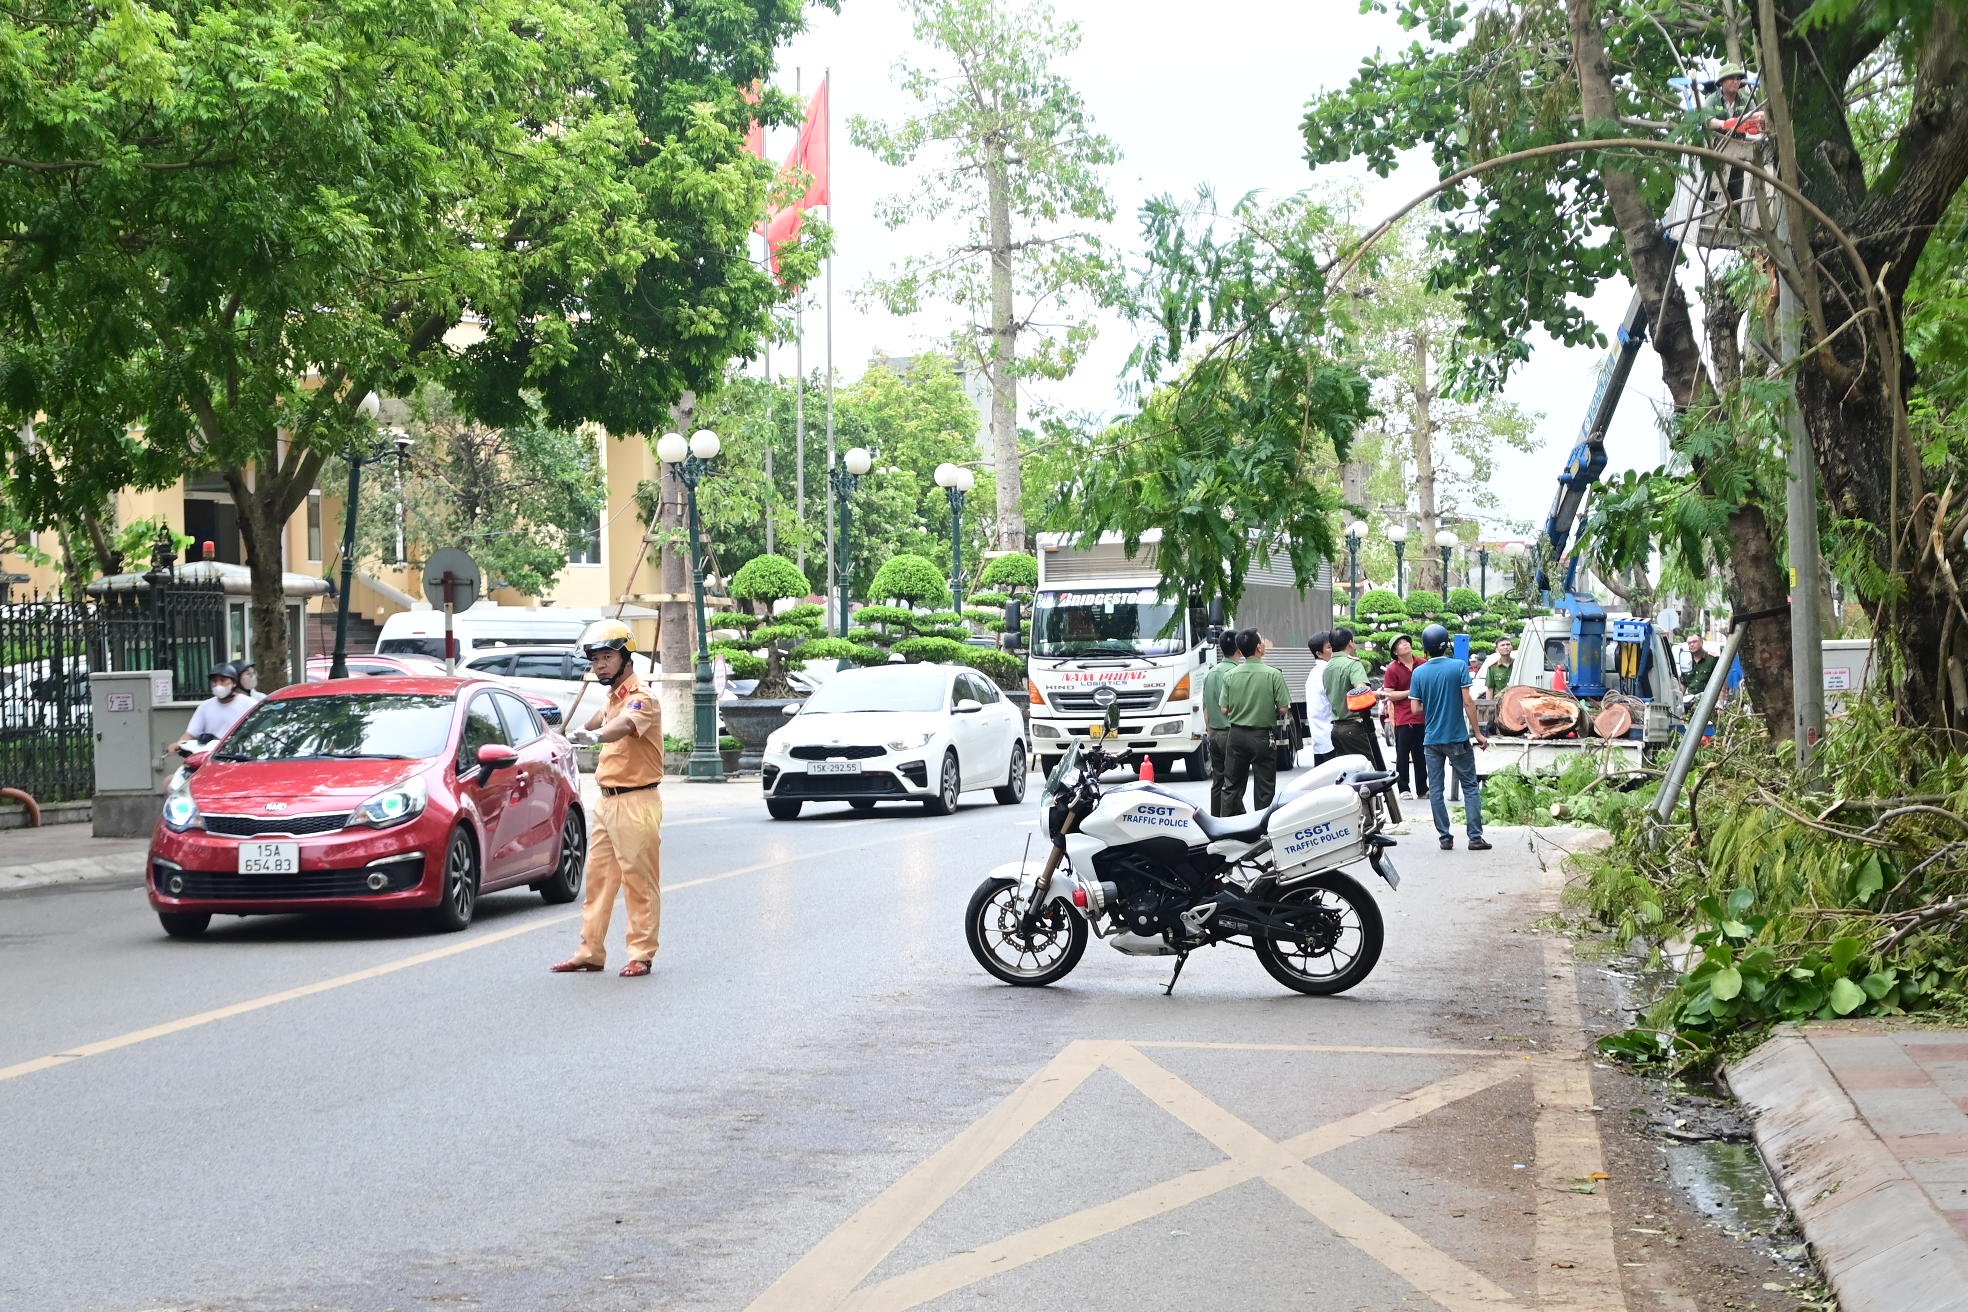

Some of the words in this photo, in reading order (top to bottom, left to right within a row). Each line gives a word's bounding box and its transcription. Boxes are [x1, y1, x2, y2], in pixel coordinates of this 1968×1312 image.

[1057, 592, 1159, 607] BRIDGESTO
[1137, 805, 1175, 816] CSGT
[1122, 814, 1157, 825] TRAFFIC
[1158, 818, 1189, 828] POLICE
[1294, 821, 1331, 841] CSGT
[1284, 838, 1320, 855] TRAFFIC
[1320, 828, 1351, 844] POLICE
[257, 844, 281, 857] 15A
[245, 858, 292, 872] 654.83
